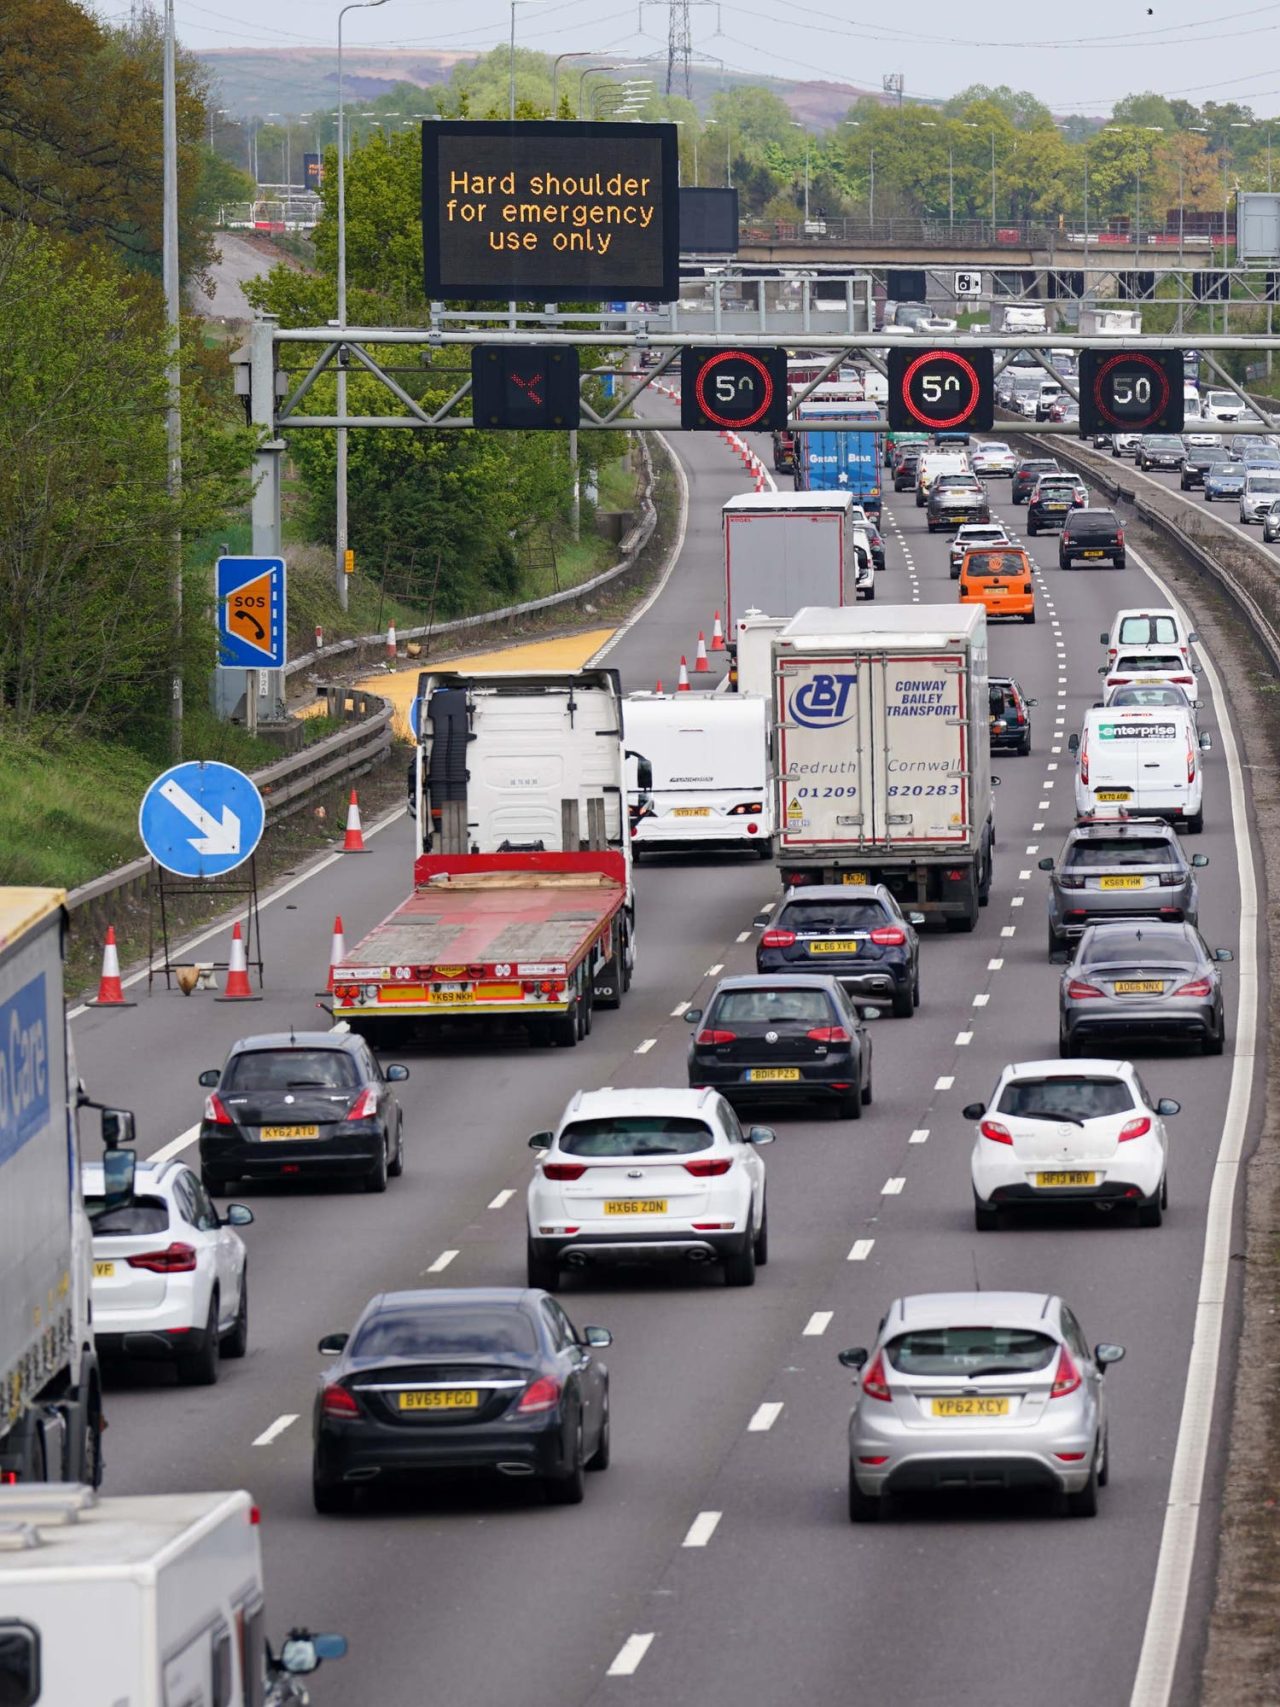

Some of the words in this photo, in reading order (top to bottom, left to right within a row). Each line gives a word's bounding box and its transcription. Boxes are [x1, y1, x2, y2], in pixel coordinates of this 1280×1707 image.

[451, 171, 515, 195] Hard
[530, 172, 650, 196] shoulder
[447, 200, 487, 222] for
[503, 204, 654, 228] emergency
[489, 231, 538, 250] use
[553, 228, 611, 255] only
[1113, 377, 1151, 403] 50
[234, 596, 265, 607] SOS
[895, 680, 947, 692] CONWAY
[793, 674, 858, 718] CBT
[901, 693, 943, 705] BAILEY
[886, 705, 958, 717] TRANSPORT
[1102, 725, 1175, 736] enterprise
[789, 760, 858, 774] Redruth
[887, 758, 961, 773] Cornwall
[797, 787, 857, 799] 01209
[887, 784, 960, 797] 820283
[432, 993, 454, 1003] YK69
[455, 992, 473, 1002] NKH
[9, 1009, 46, 1117] Care
[264, 1127, 292, 1138] KY62
[608, 1201, 639, 1213] HX66
[406, 1393, 442, 1407] BV65
[937, 1400, 973, 1413] YP62
[975, 1399, 1004, 1412] XCY
